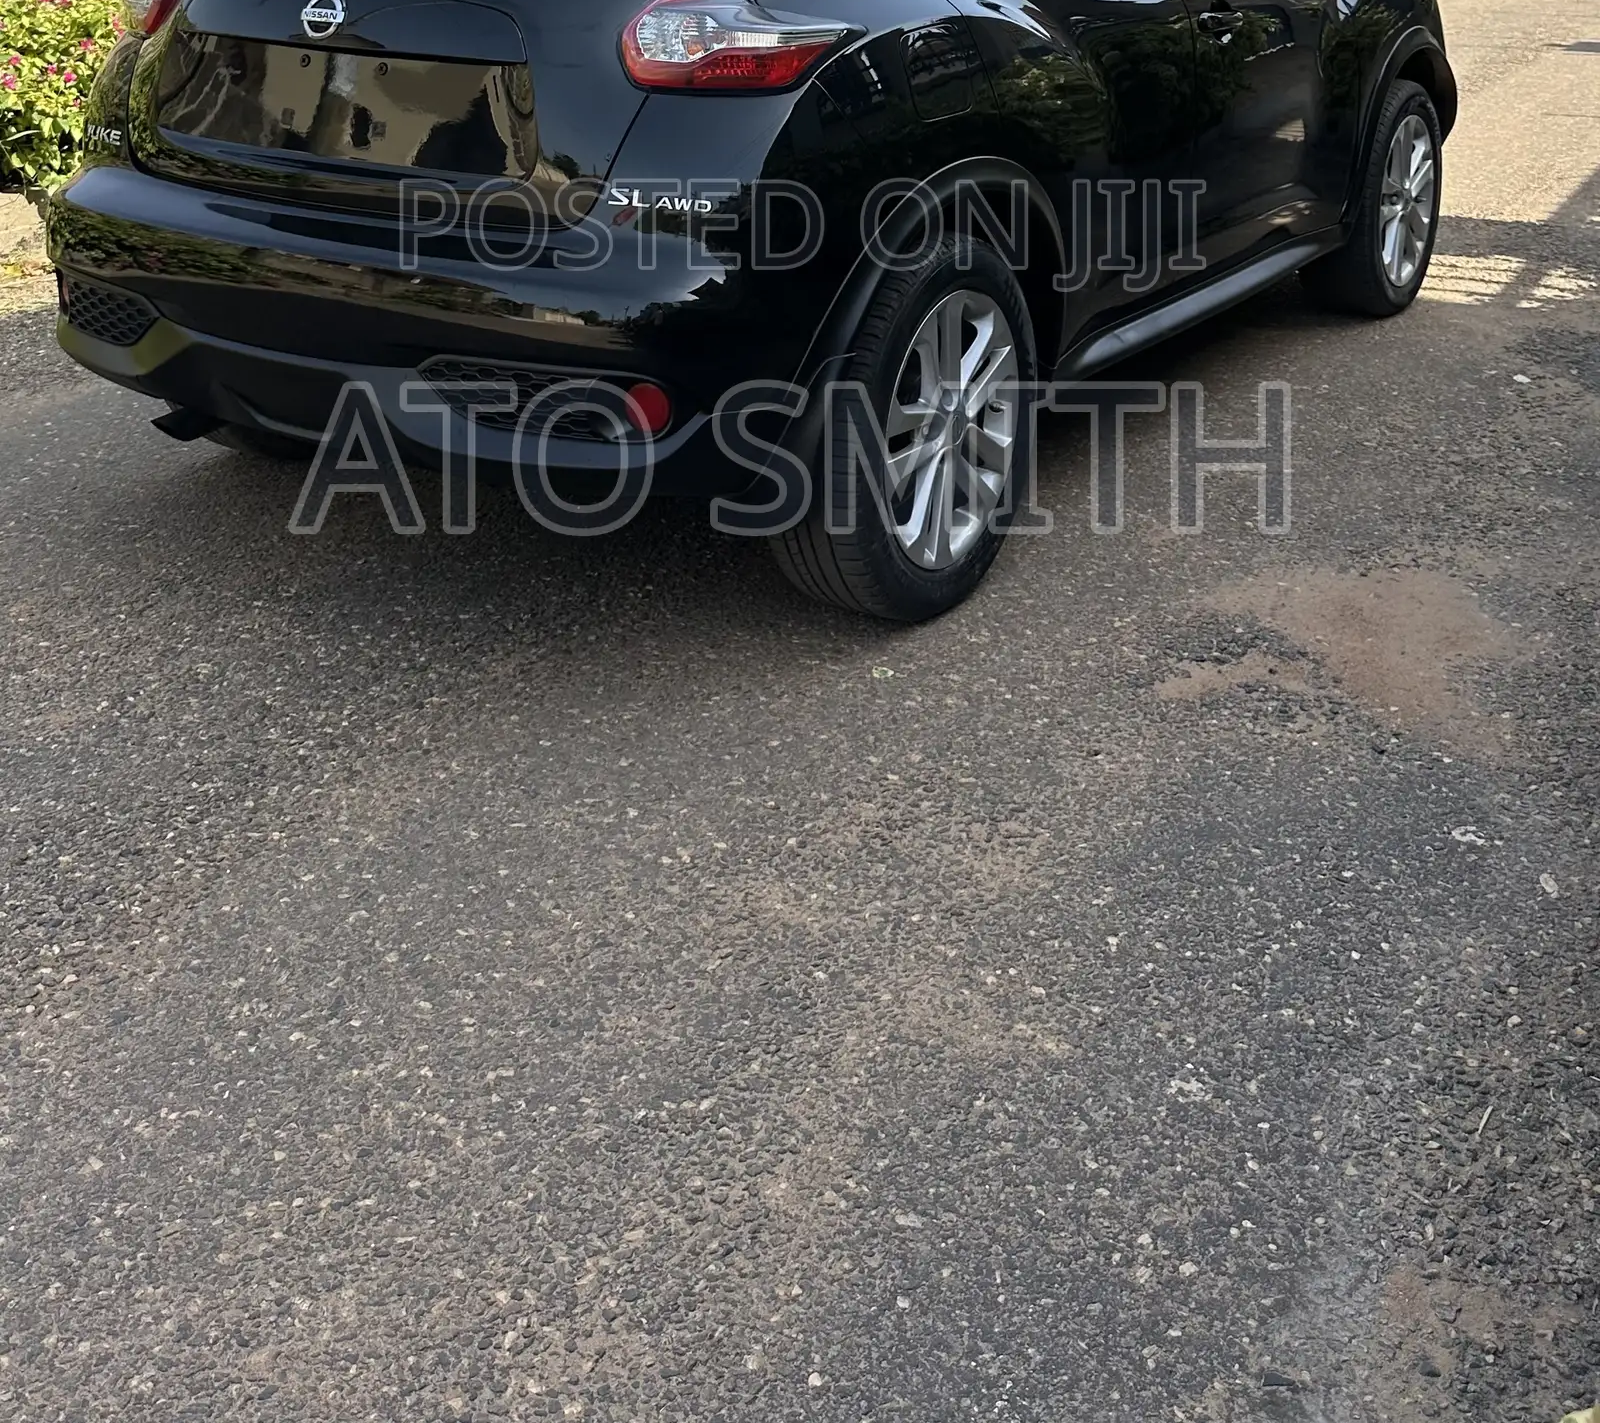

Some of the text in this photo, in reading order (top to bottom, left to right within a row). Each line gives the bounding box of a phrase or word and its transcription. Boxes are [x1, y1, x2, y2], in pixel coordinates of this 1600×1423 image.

[304, 10, 338, 20] NISSAN
[85, 123, 122, 146] JUKE
[607, 188, 712, 213] SL AWD
